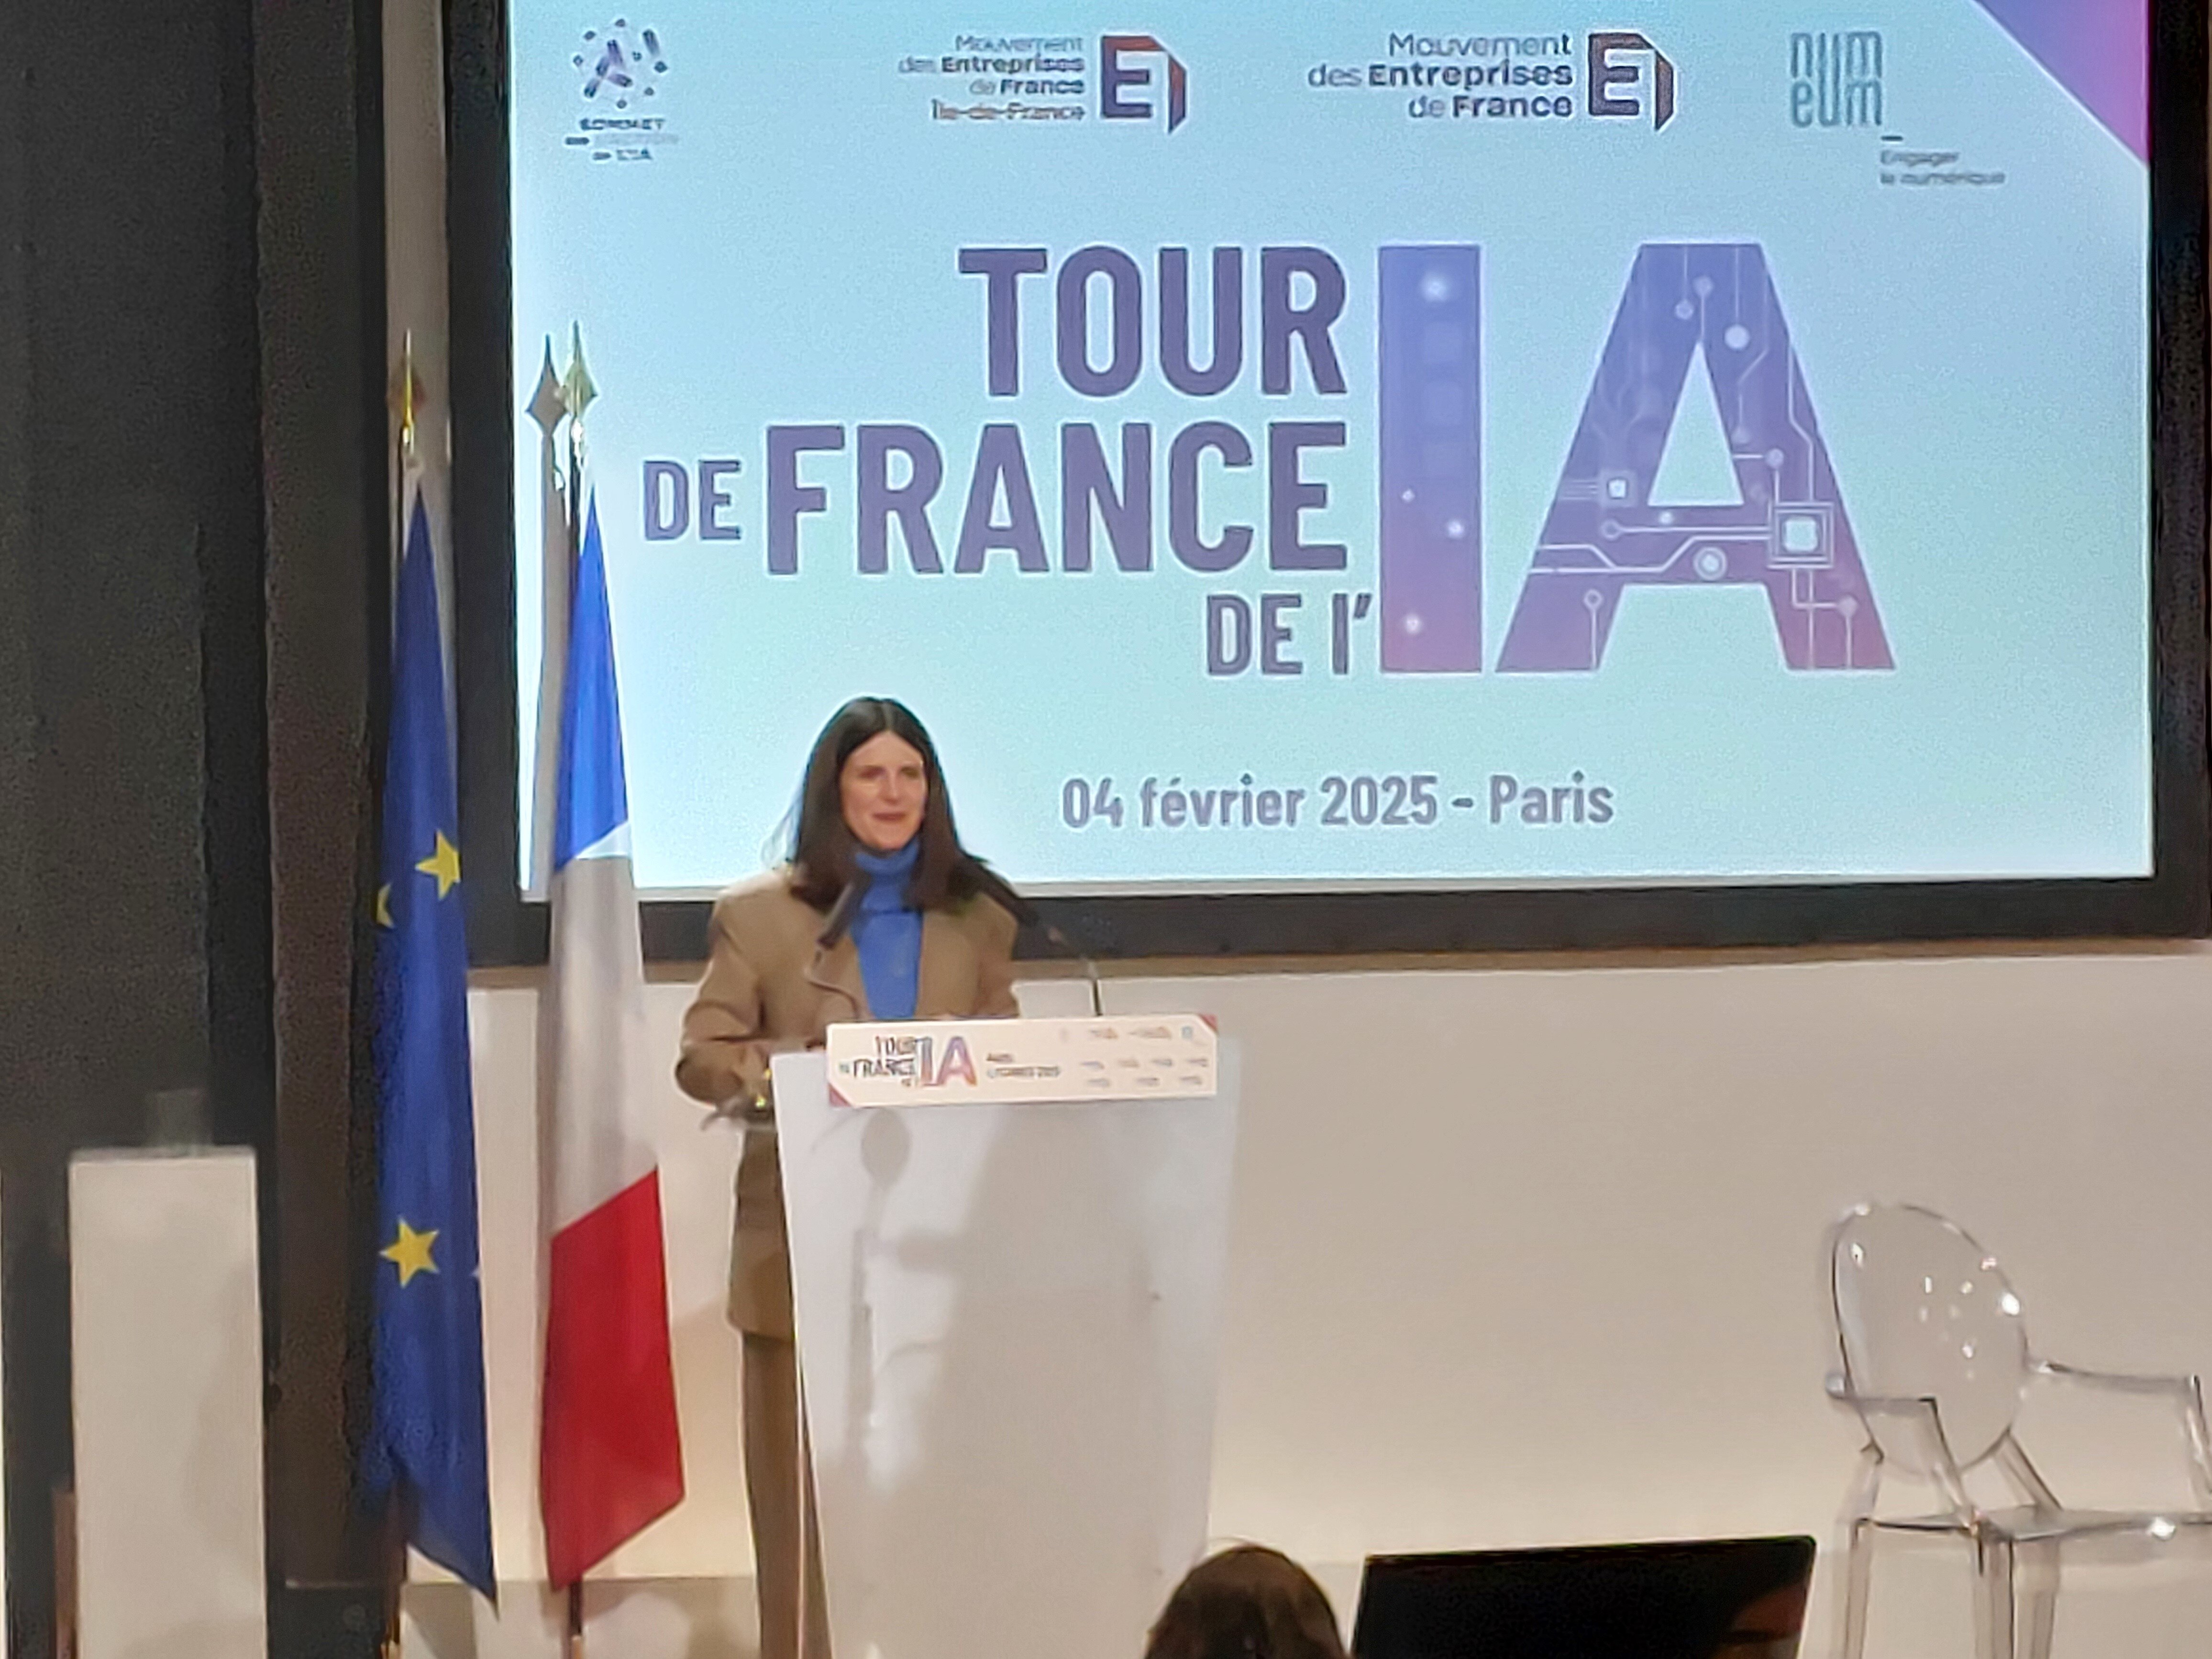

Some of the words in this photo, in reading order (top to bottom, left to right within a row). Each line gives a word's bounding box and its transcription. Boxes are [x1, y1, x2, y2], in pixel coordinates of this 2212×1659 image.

[941, 53, 1084, 74] Entreprises
[1389, 33, 1572, 56] Mouvement
[1001, 79, 1084, 94] France
[1308, 63, 1362, 87] des
[1369, 59, 1573, 91] Entreprises
[1408, 96, 1446, 118] de
[1453, 96, 1573, 118] France
[958, 246, 1347, 396] TOUR
[1379, 244, 1896, 672] IA
[643, 459, 741, 541] DE
[766, 421, 1347, 574] FRANCE
[1206, 593, 1302, 675] DE
[1062, 777, 1124, 828] 04
[1139, 773, 1306, 828] février
[1320, 775, 1438, 826] 2025
[1490, 770, 1613, 824] Paris
